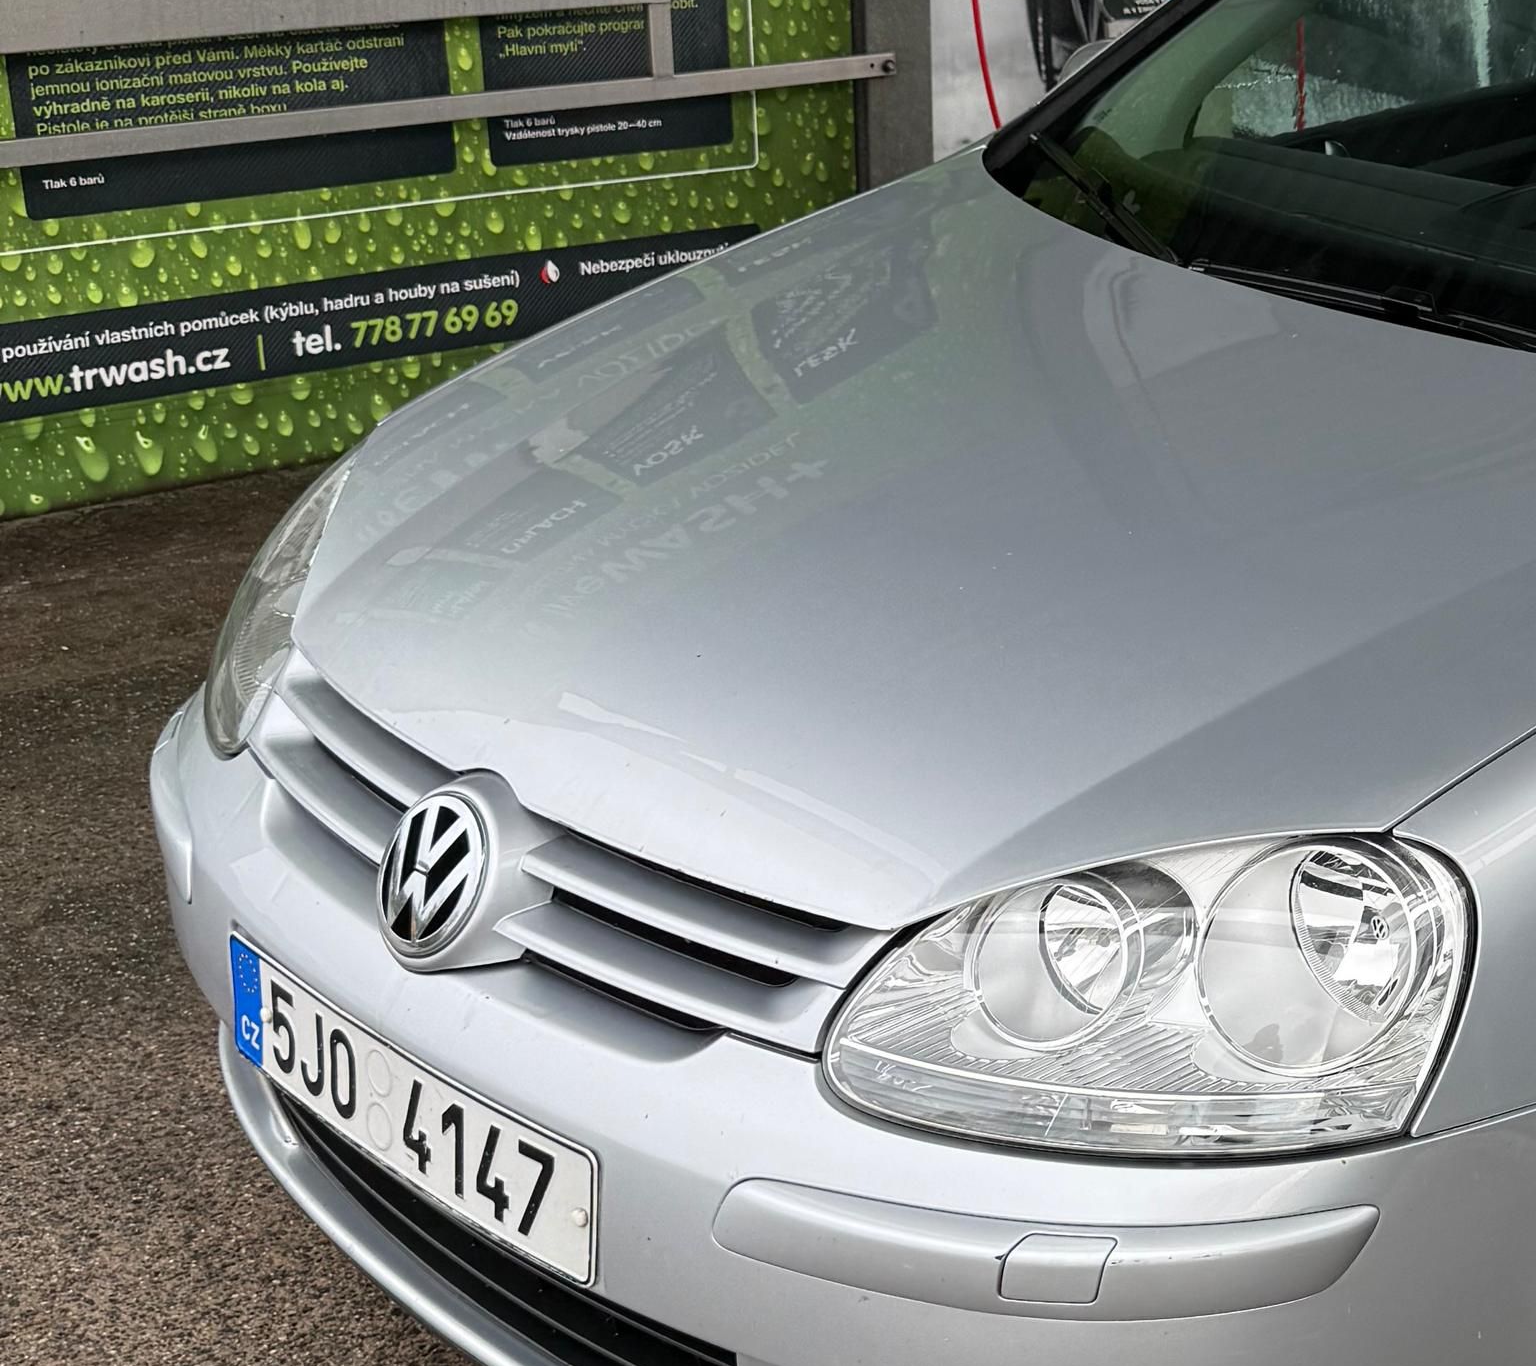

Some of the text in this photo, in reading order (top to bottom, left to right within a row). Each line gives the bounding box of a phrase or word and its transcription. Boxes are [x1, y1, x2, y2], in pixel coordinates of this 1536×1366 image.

[497, 21, 596, 39] Pak pokračujte
[28, 64, 49, 78] po
[56, 55, 150, 74] zákazníkovi
[155, 51, 192, 68] před
[244, 42, 292, 58] Měkký
[31, 56, 368, 99] jemnou ionizační matovou vrstvu. Používejte
[33, 78, 348, 118] výhradně na karoserii, nikoliv na kola aj.
[504, 119, 662, 140] Vzdálenost trysky pistole cm
[42, 172, 105, 190] Tlak 6 barů
[580, 252, 655, 275] Nebezpečí
[2, 270, 520, 363] používání vlastních pomůcek (kýblu, hadru a houby na sušení)
[0, 347, 231, 403] ww.trwash.cz
[292, 324, 342, 358] tel.
[444, 305, 479, 333] 69
[484, 299, 519, 328] 69
[240, 1015, 262, 1051] CZ
[270, 979, 555, 1237] 5J0 4147
